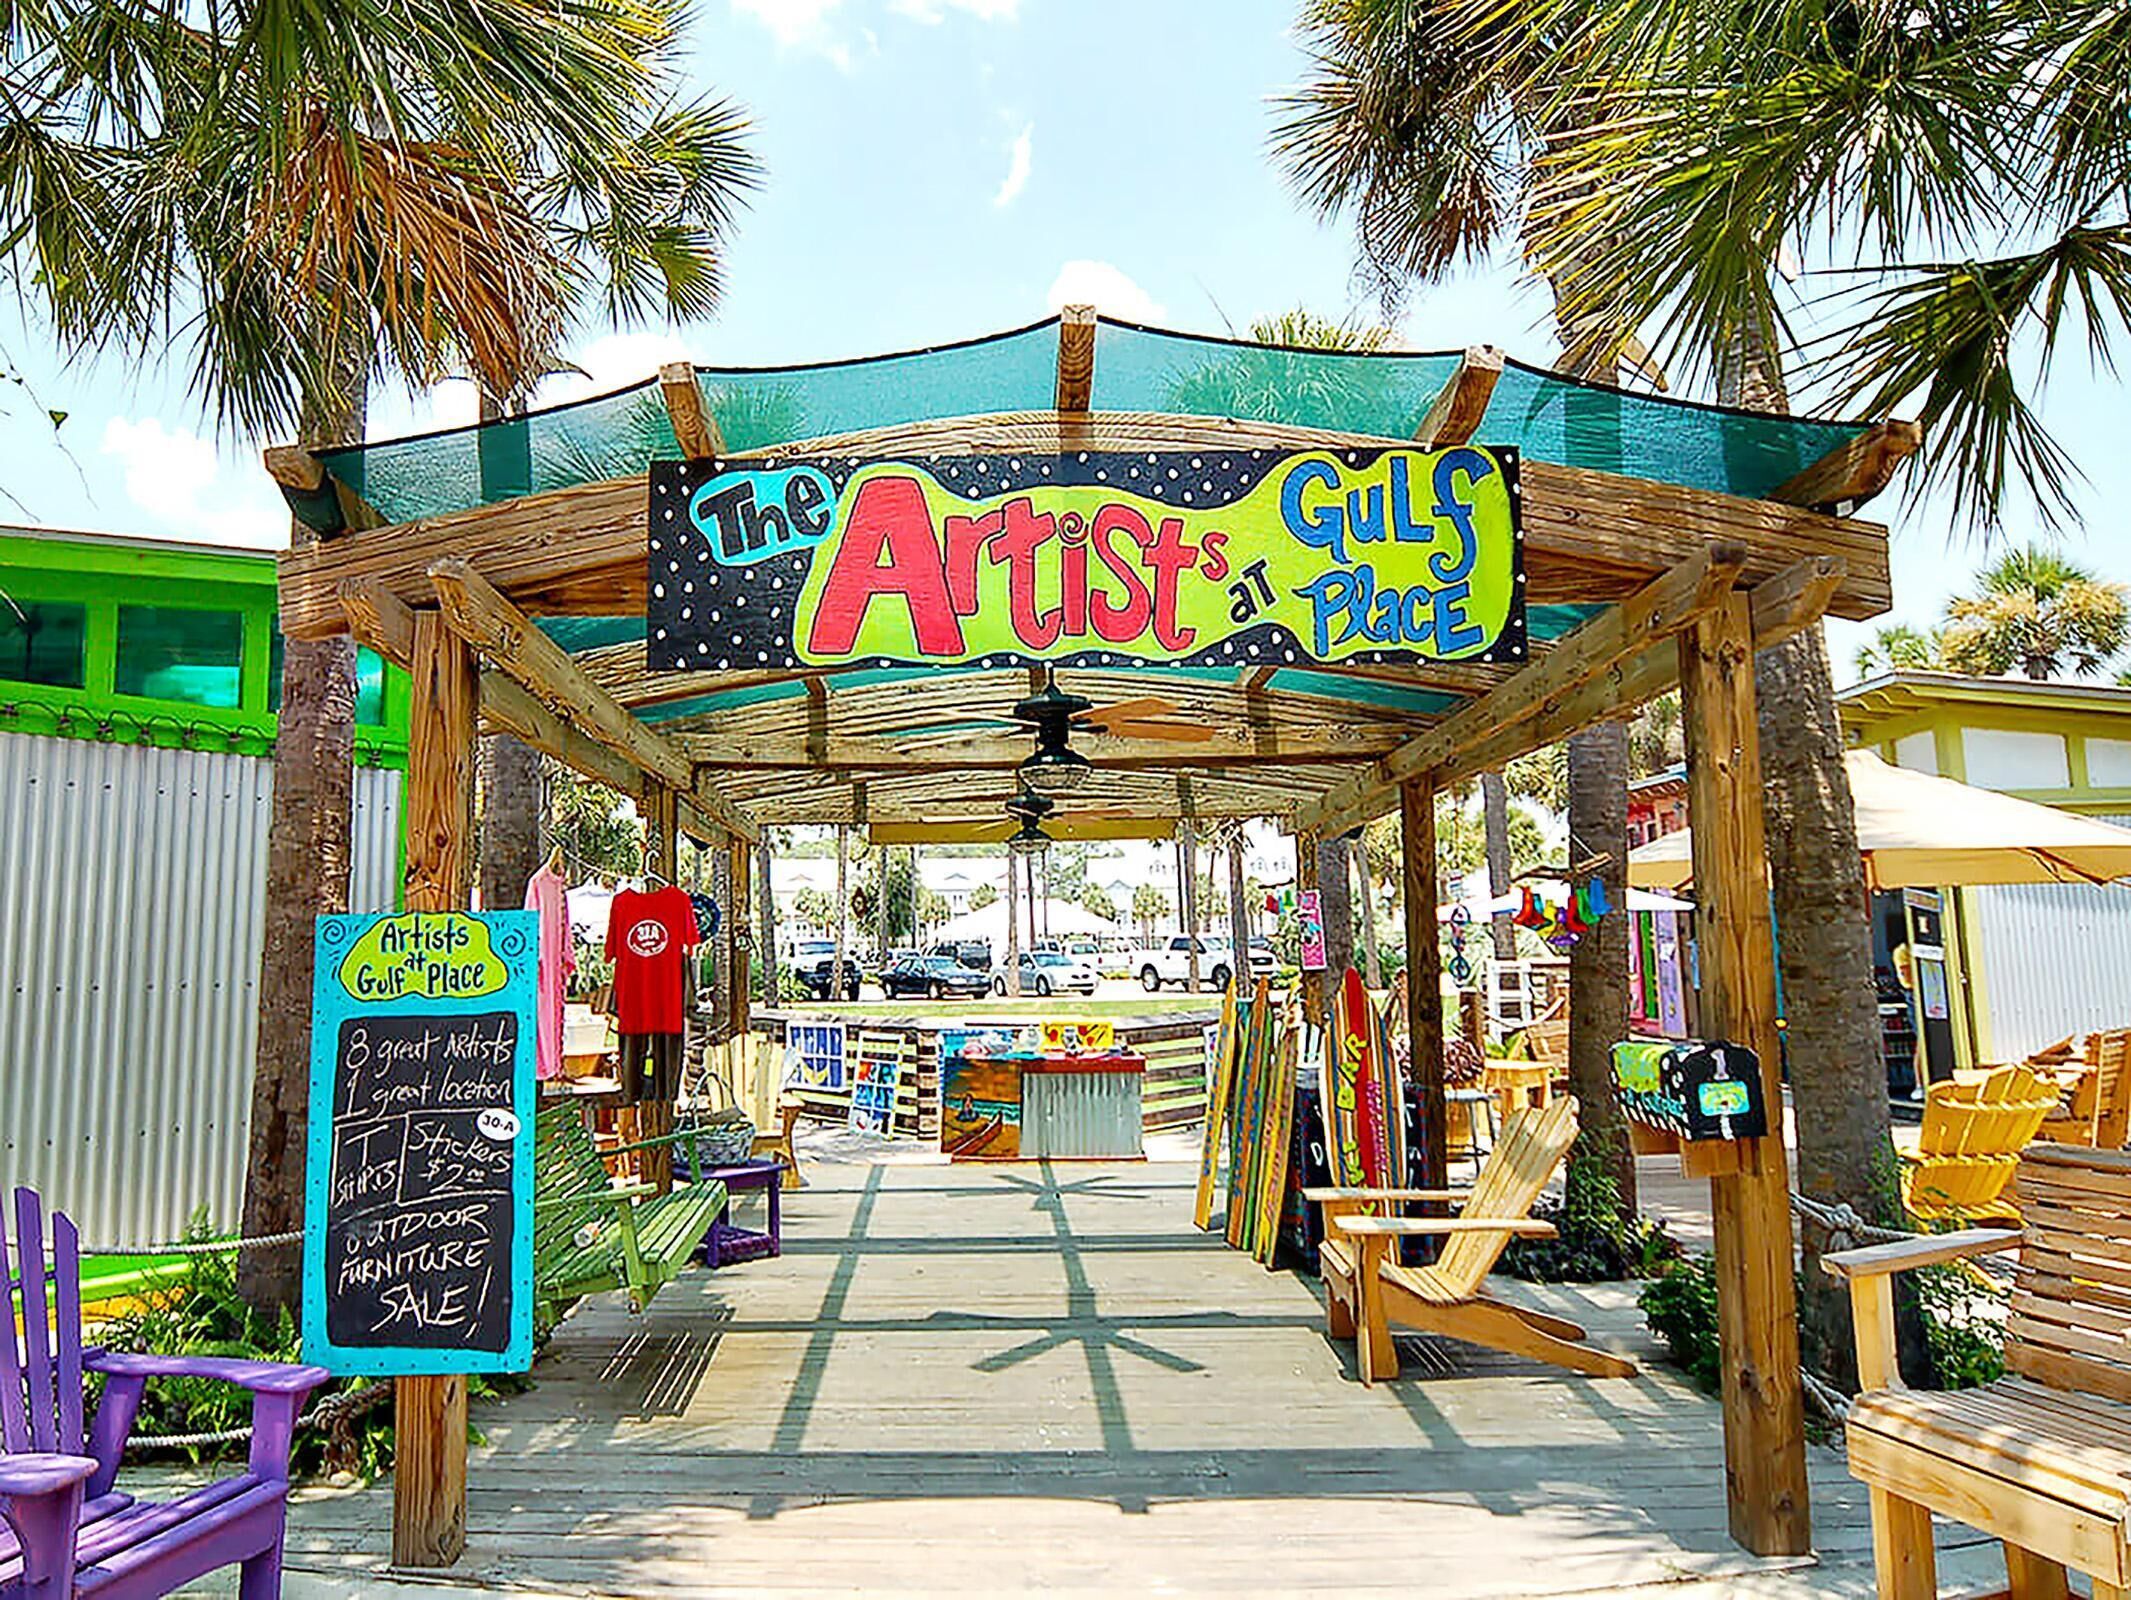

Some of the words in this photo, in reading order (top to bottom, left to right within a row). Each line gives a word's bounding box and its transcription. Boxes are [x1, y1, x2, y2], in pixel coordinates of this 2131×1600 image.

[697, 475, 832, 557] The
[381, 915, 469, 953] Artists
[357, 964, 405, 995] Gulf
[428, 963, 484, 994] Place
[404, 952, 426, 971] at
[346, 1028, 370, 1069] 8
[375, 1029, 440, 1079] great
[372, 1070, 432, 1120] great
[439, 1065, 512, 1104] location
[344, 1124, 389, 1167] T
[346, 1204, 490, 1254] OUTDOOR
[337, 1238, 491, 1295] FURNITURE
